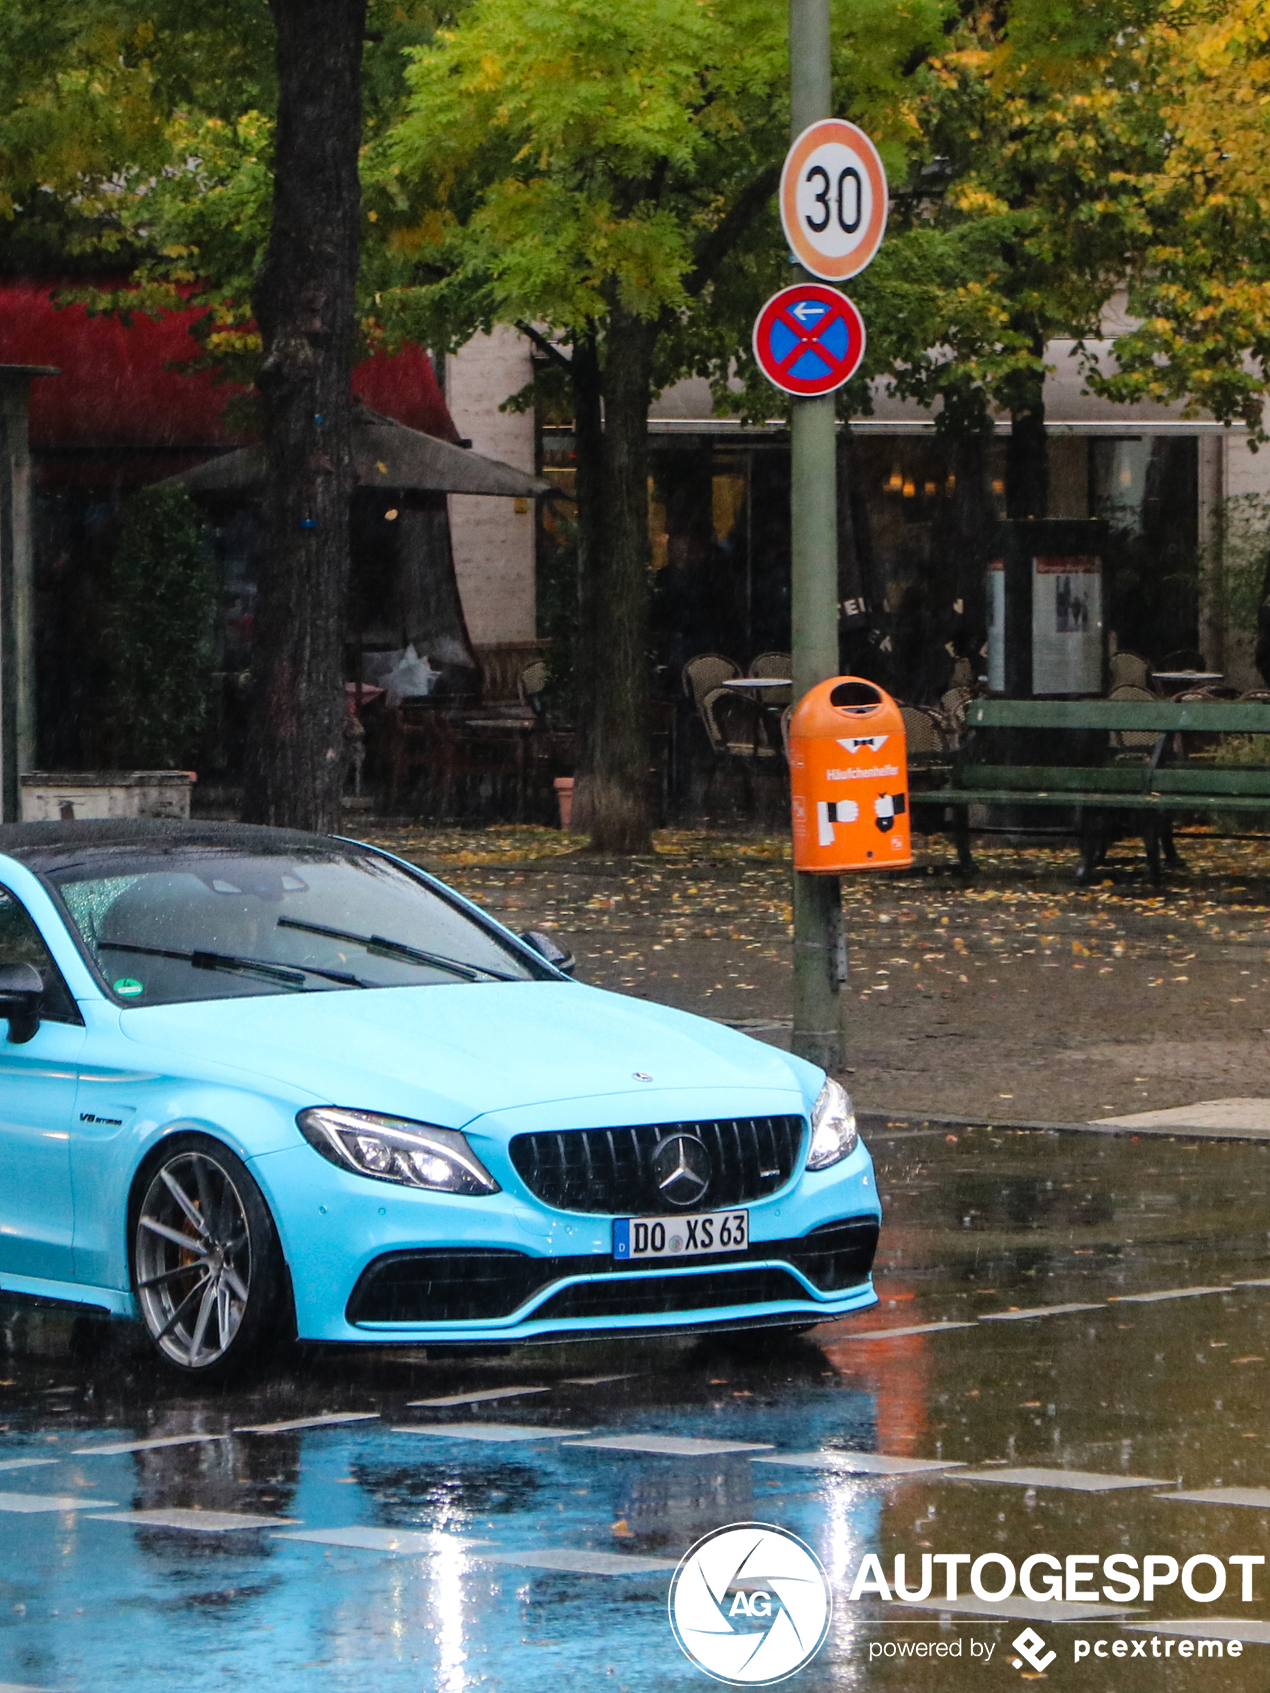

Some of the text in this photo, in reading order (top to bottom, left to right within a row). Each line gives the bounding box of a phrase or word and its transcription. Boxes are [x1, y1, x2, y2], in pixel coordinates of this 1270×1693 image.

[805, 165, 862, 234] 30
[618, 1215, 746, 1253] D DO XS 63
